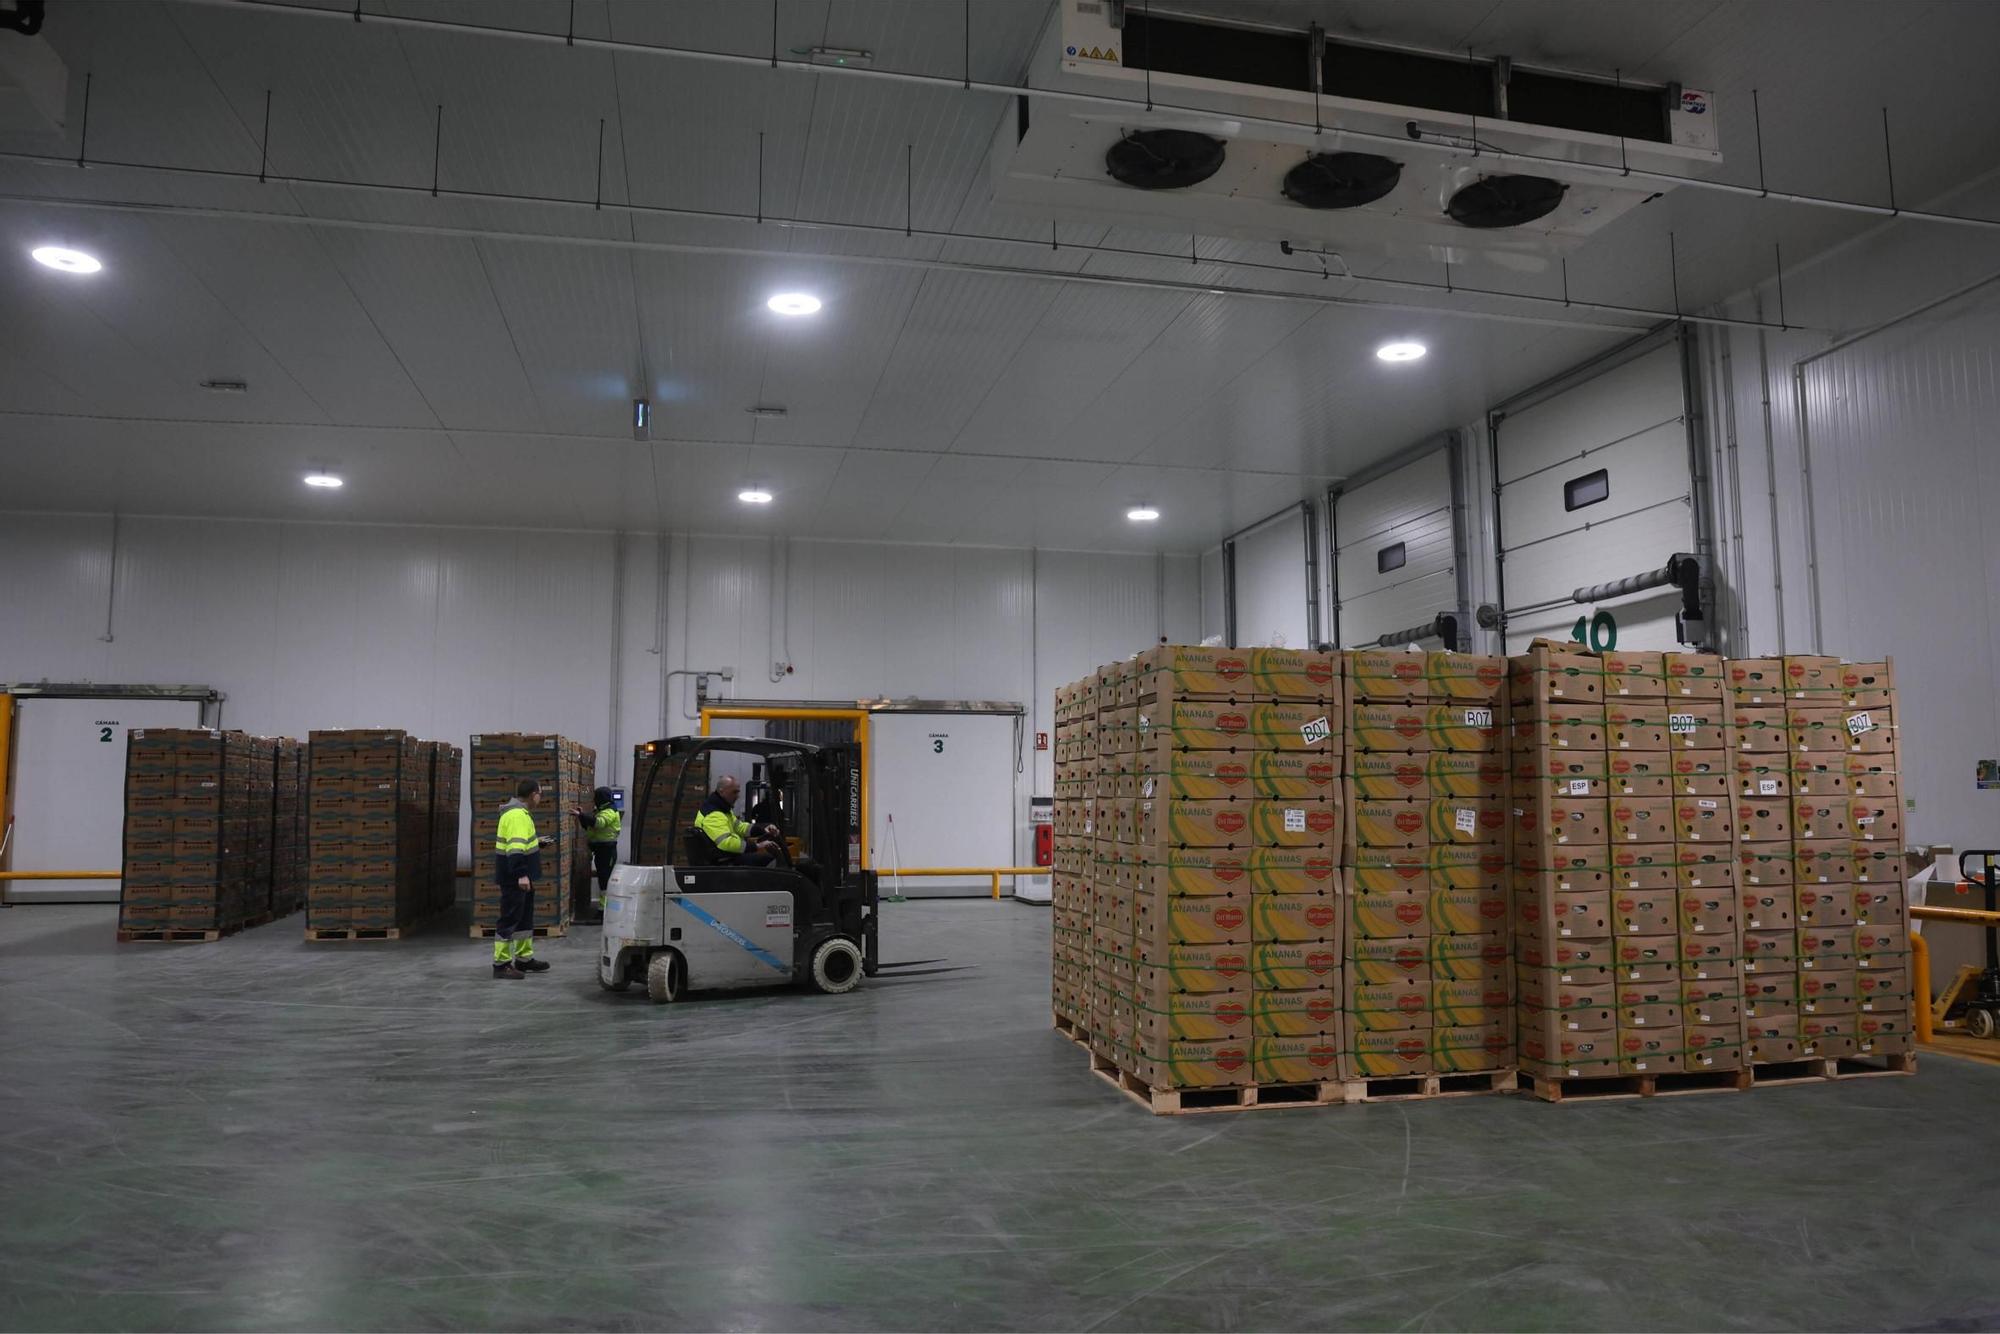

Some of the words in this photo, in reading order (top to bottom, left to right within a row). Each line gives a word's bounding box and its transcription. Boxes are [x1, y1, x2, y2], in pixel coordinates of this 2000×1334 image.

[1571, 611, 1617, 652] 10
[1468, 711, 1490, 726] B07
[1671, 716, 1693, 731] B07
[1849, 714, 1868, 733] B07
[100, 727, 113, 742] 2
[1304, 719, 1326, 742] B07
[934, 739, 943, 754] 3
[1572, 782, 1586, 790] ESP
[1762, 783, 1775, 791] ESP
